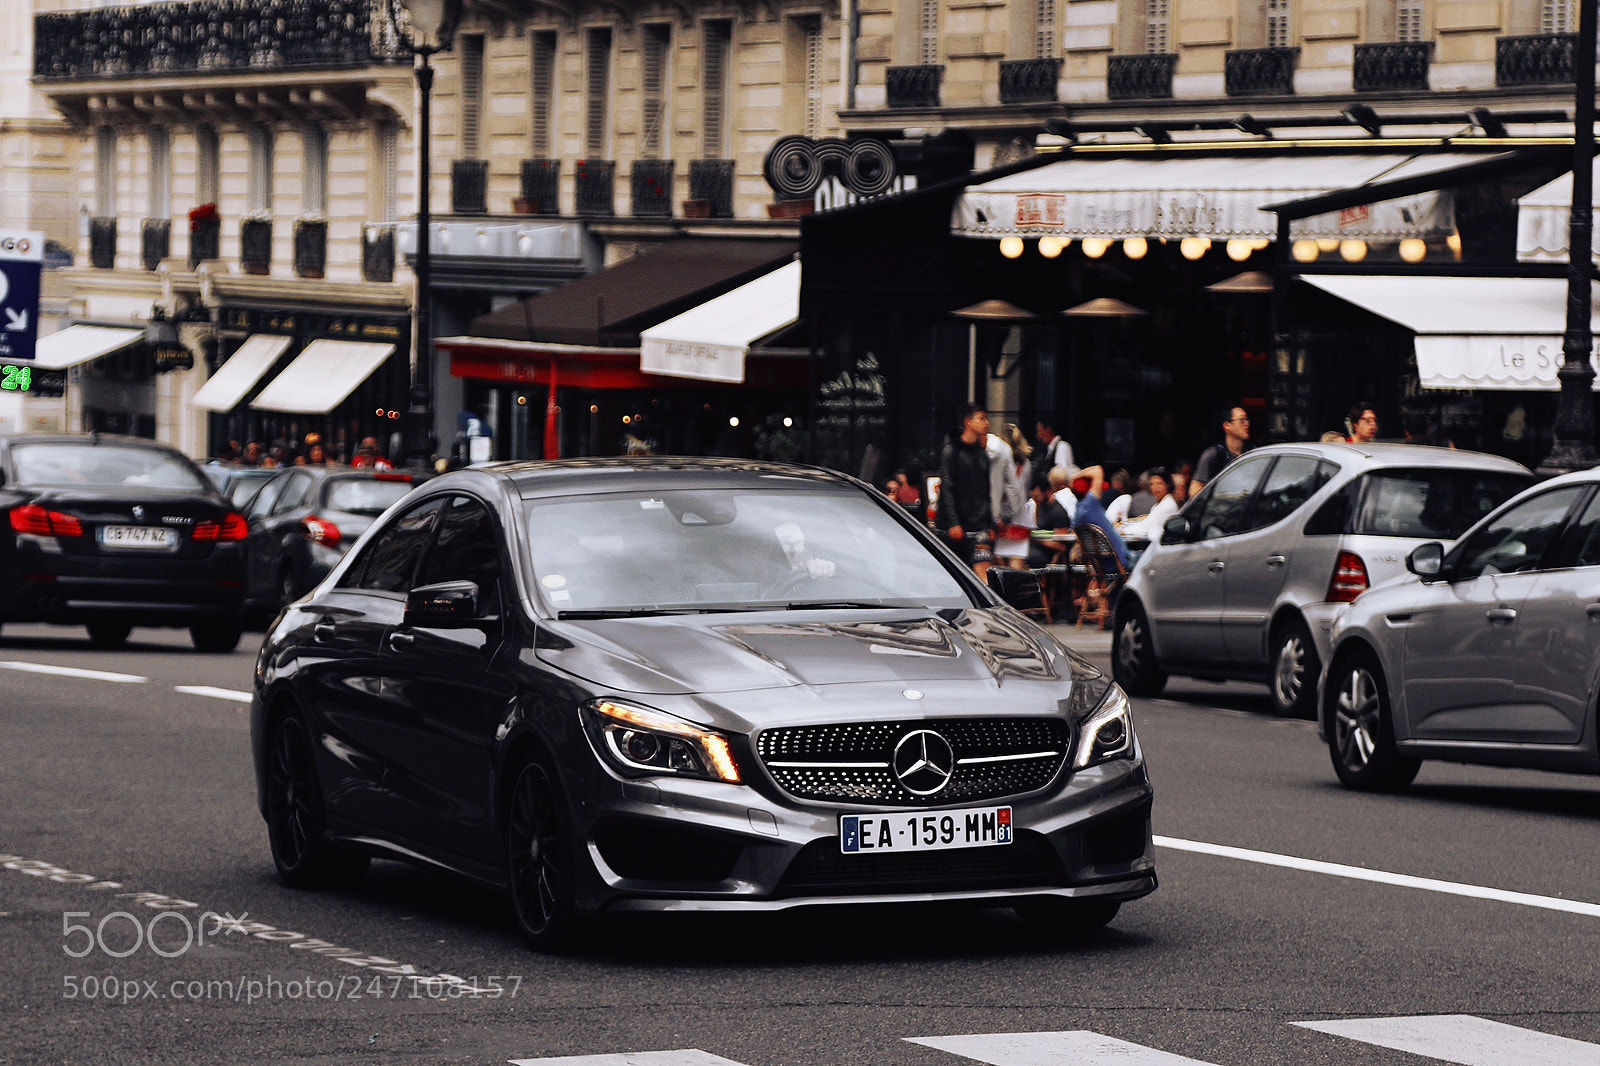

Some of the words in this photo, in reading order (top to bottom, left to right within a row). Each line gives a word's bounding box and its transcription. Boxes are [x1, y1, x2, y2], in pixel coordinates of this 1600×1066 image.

[1, 365, 31, 391] 24
[847, 837, 854, 847] F
[998, 826, 1011, 840] 81
